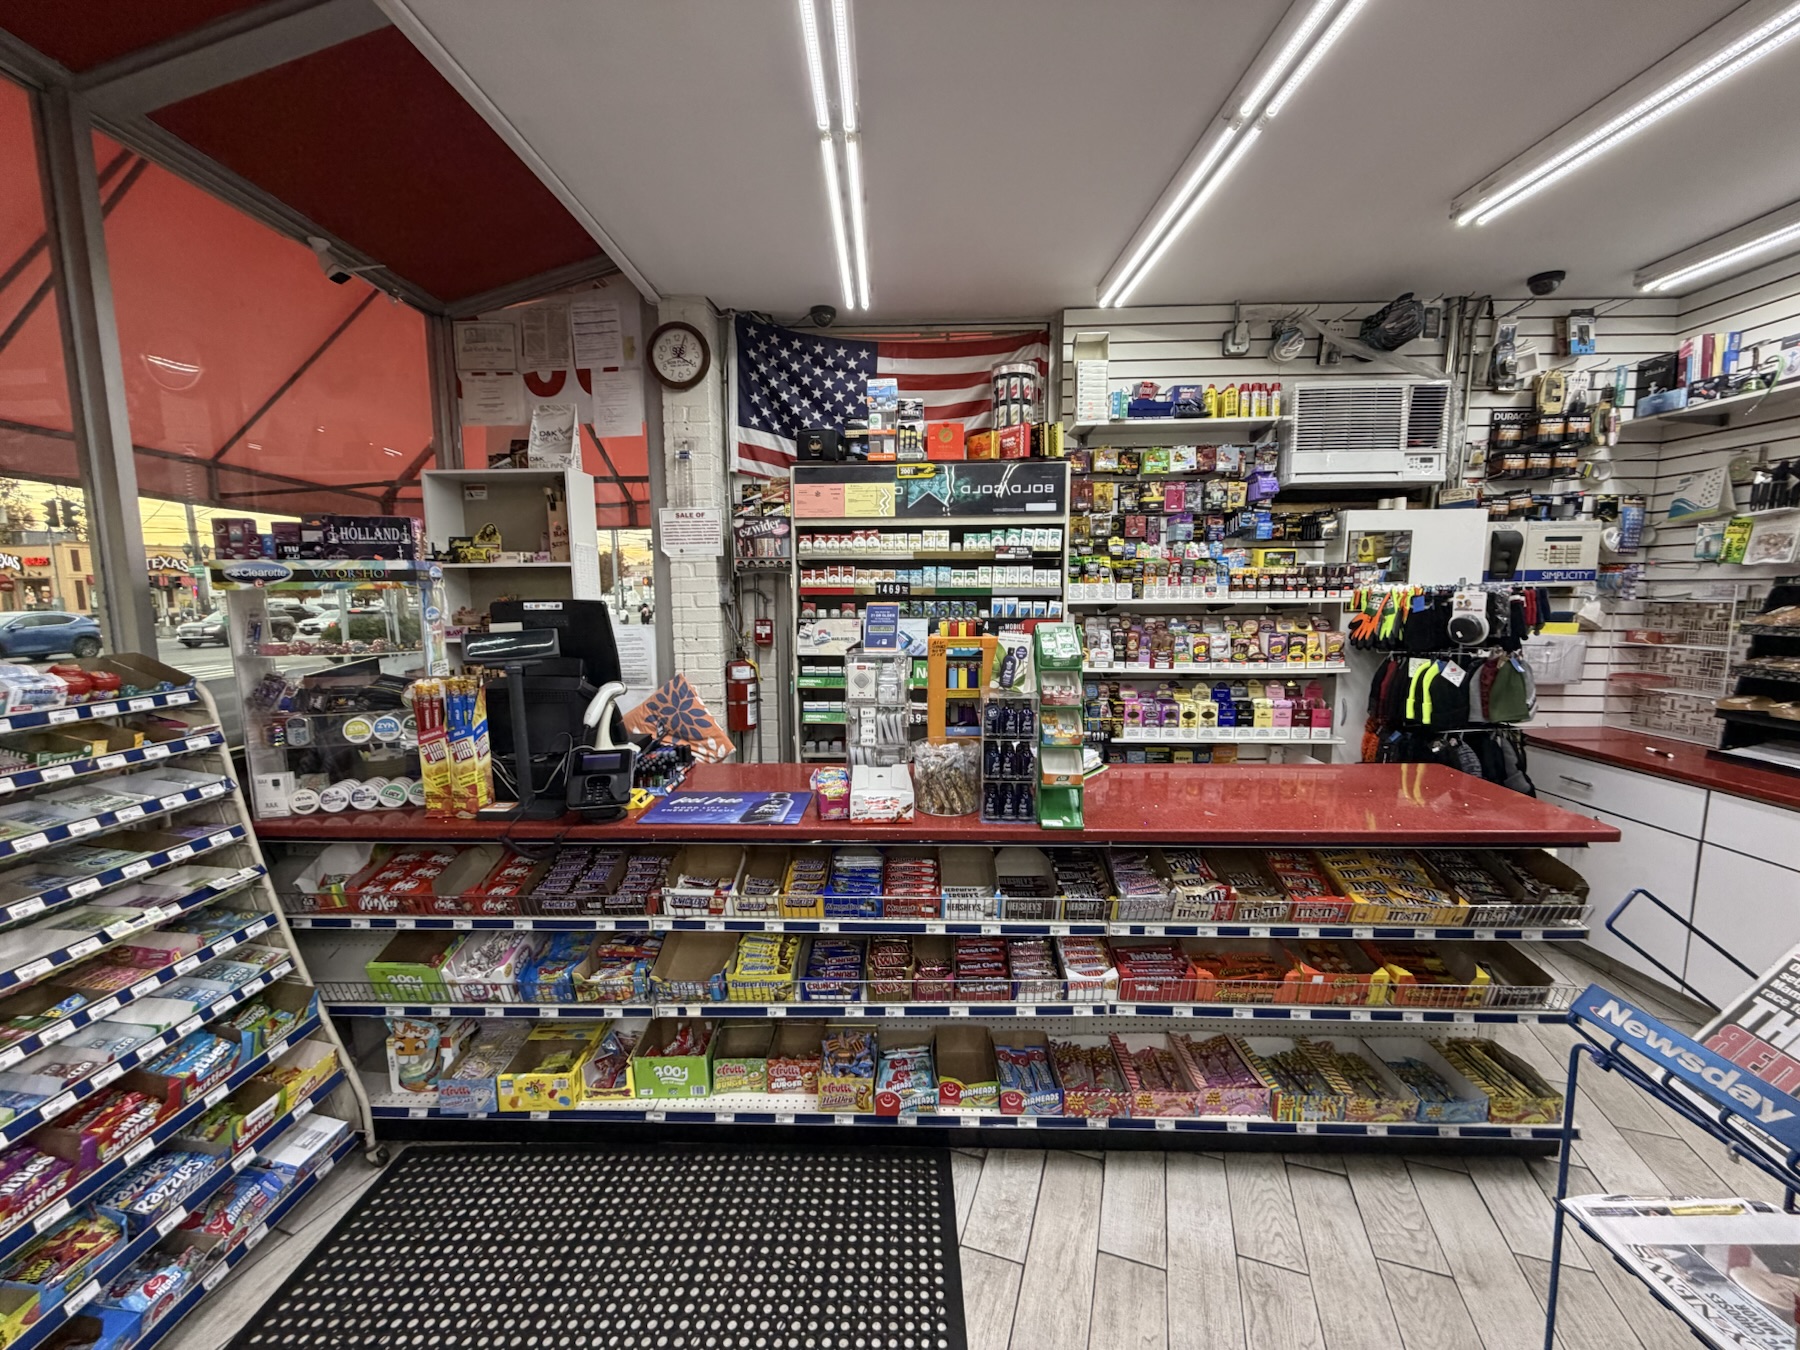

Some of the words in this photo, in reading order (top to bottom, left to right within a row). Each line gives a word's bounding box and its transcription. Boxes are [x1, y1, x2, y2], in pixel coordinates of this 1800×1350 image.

[340, 527, 400, 541] HOLLAND
[1541, 570, 1590, 580] SIMPLICITY
[1004, 623, 1025, 631] MOBILE
[377, 722, 395, 730] ZYN
[872, 954, 906, 967] TWIX
[1067, 957, 1103, 966] PAYDAY
[806, 982, 843, 991] CRUNCH
[870, 981, 906, 995] TWIX
[1069, 980, 1103, 991] PAYDAY
[1760, 988, 1791, 1008] race
[1598, 998, 1797, 1124] Newsday
[715, 1063, 746, 1076] efrutti
[768, 1064, 800, 1077] efrutti
[186, 1066, 233, 1104] Skittles
[771, 1079, 802, 1090] BURGER
[821, 1082, 853, 1094] efrutti
[959, 1085, 998, 1098] AIRHEADS
[899, 1096, 935, 1110] AIRHEADS
[1021, 1092, 1060, 1108] AIRHEADS
[237, 1112, 276, 1148] Skittles
[102, 1116, 157, 1163] Skittles
[135, 1159, 204, 1214] Razzles
[0, 1178, 67, 1235] Skittles
[227, 1183, 261, 1224] AIRHEADS
[1705, 1291, 1766, 1337] CHOOSES
[1733, 1303, 1785, 1338] MAYOR
